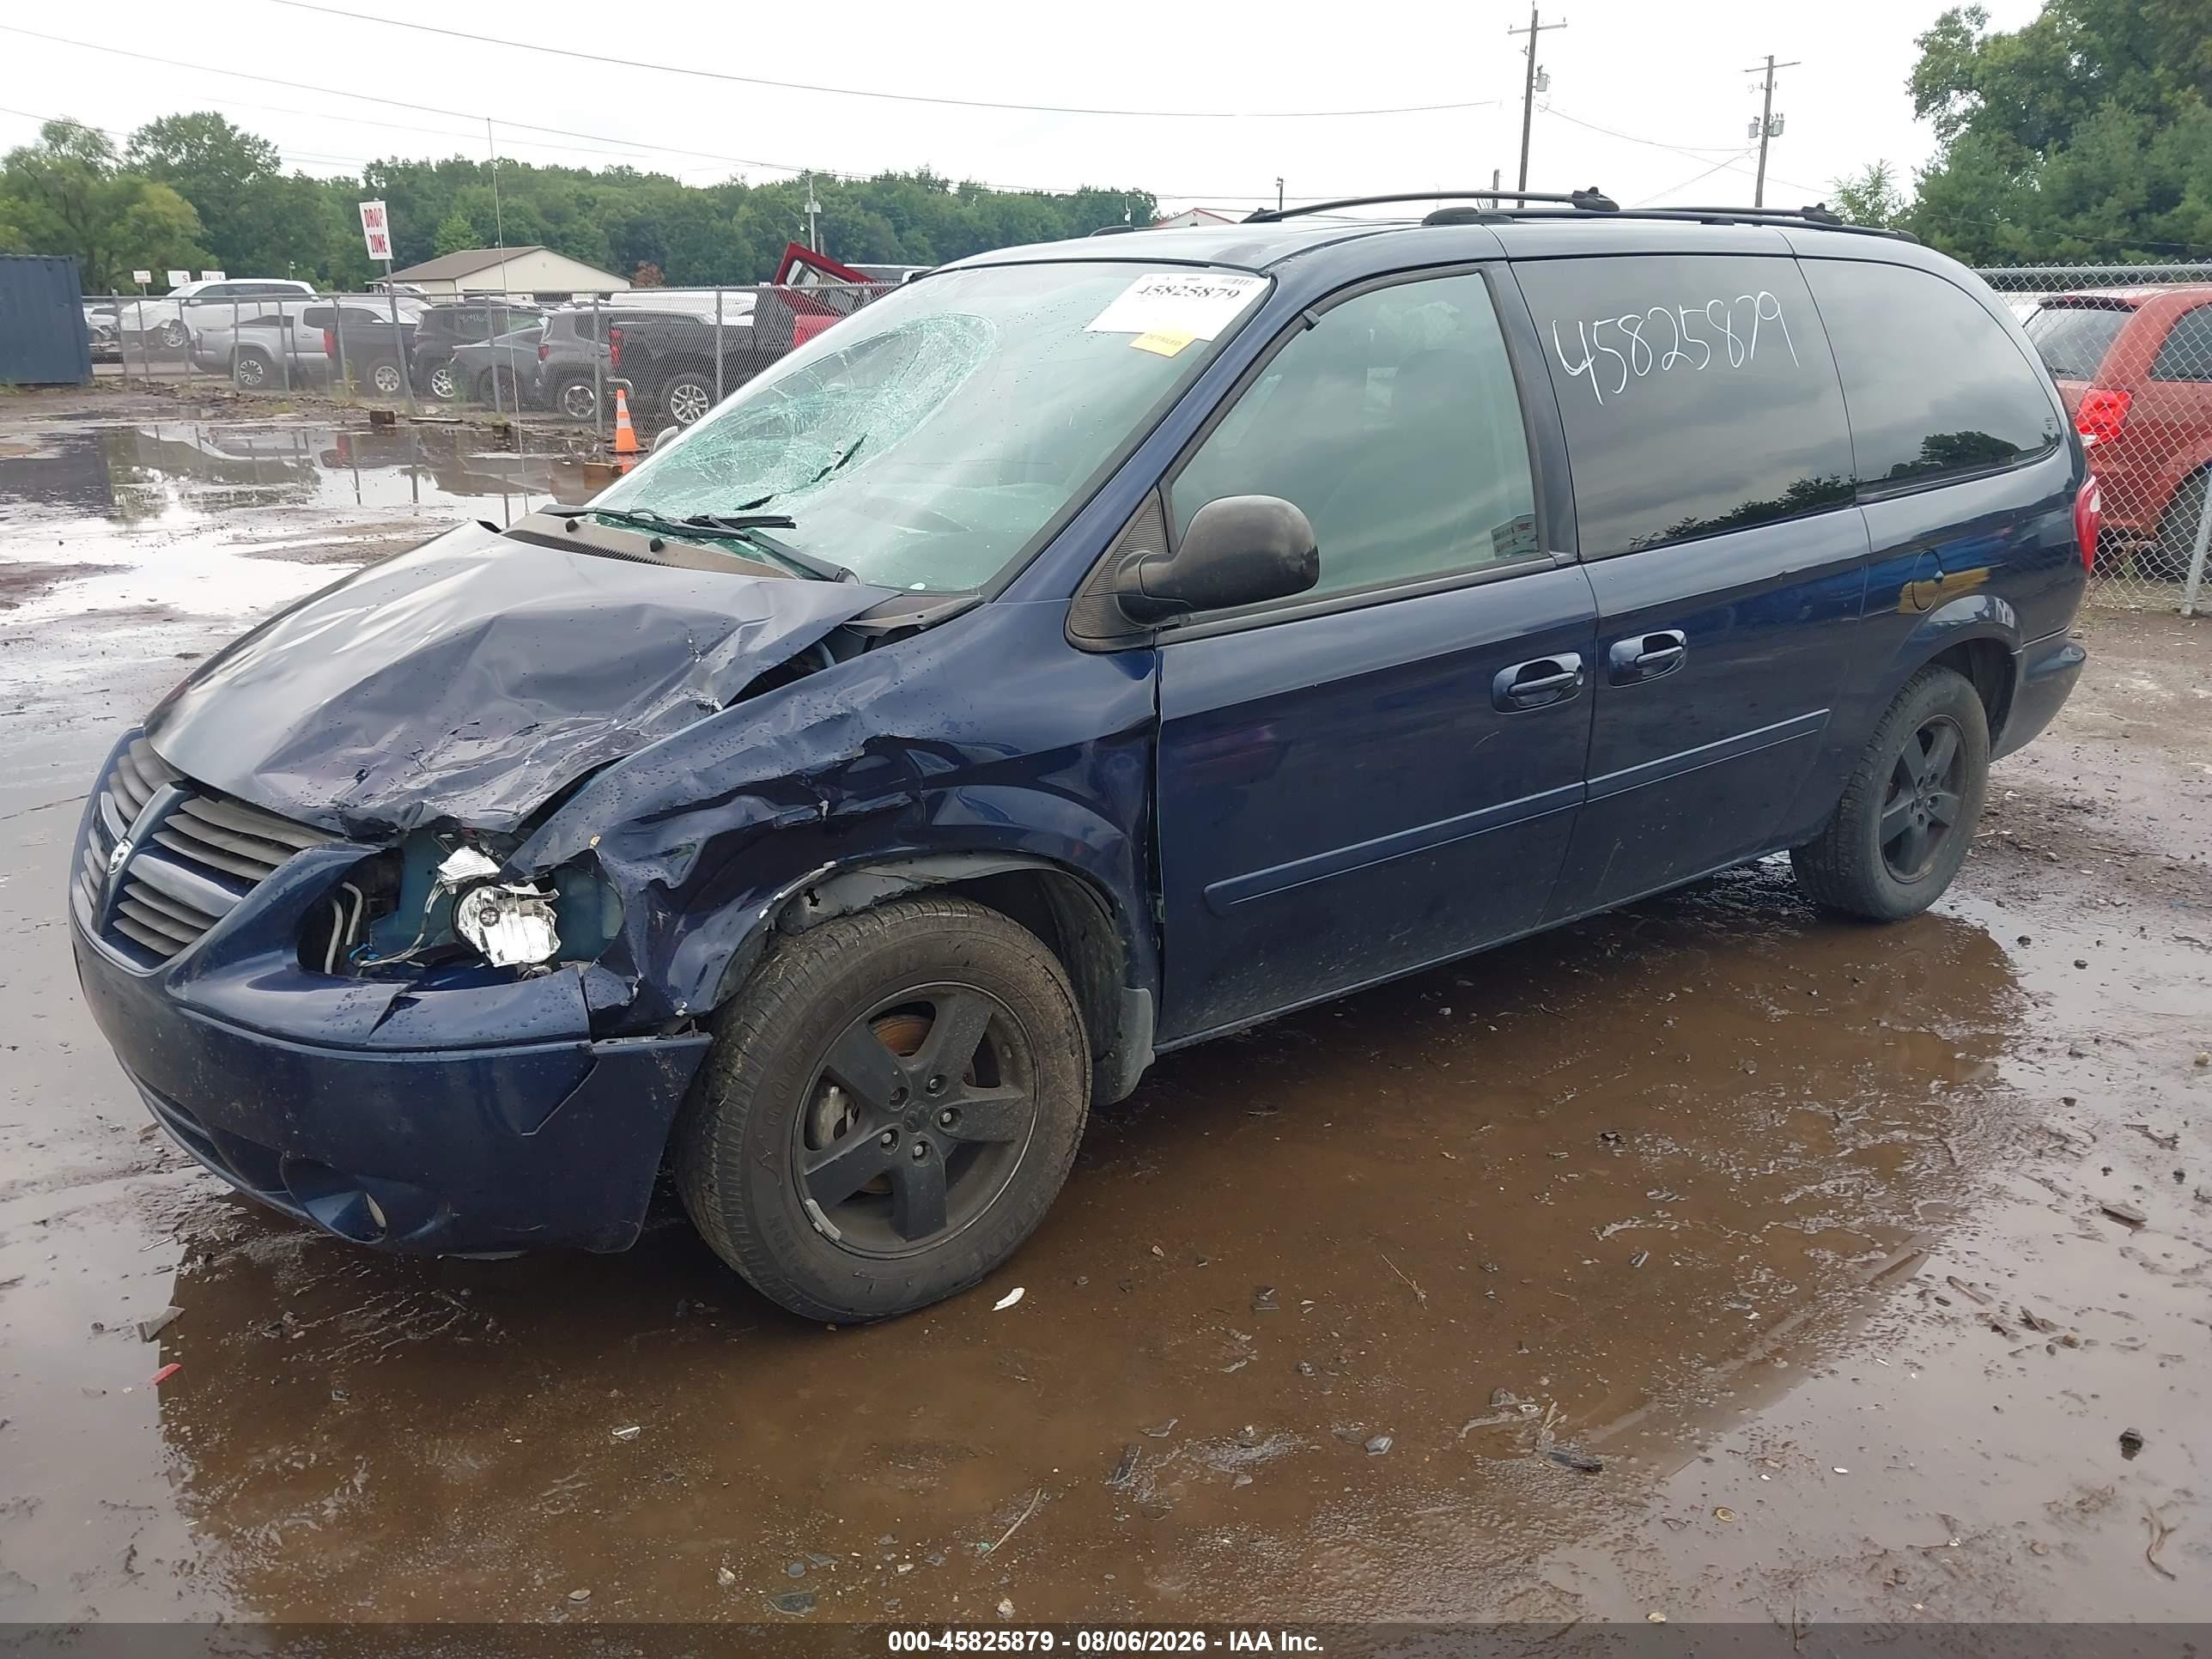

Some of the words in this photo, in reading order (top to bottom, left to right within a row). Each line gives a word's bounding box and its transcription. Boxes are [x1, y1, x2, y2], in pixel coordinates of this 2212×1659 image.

[364, 208, 383, 228] DROP
[369, 234, 387, 253] ZONE
[1137, 285, 1241, 300] 45825879
[1553, 291, 1799, 405] 45825879
